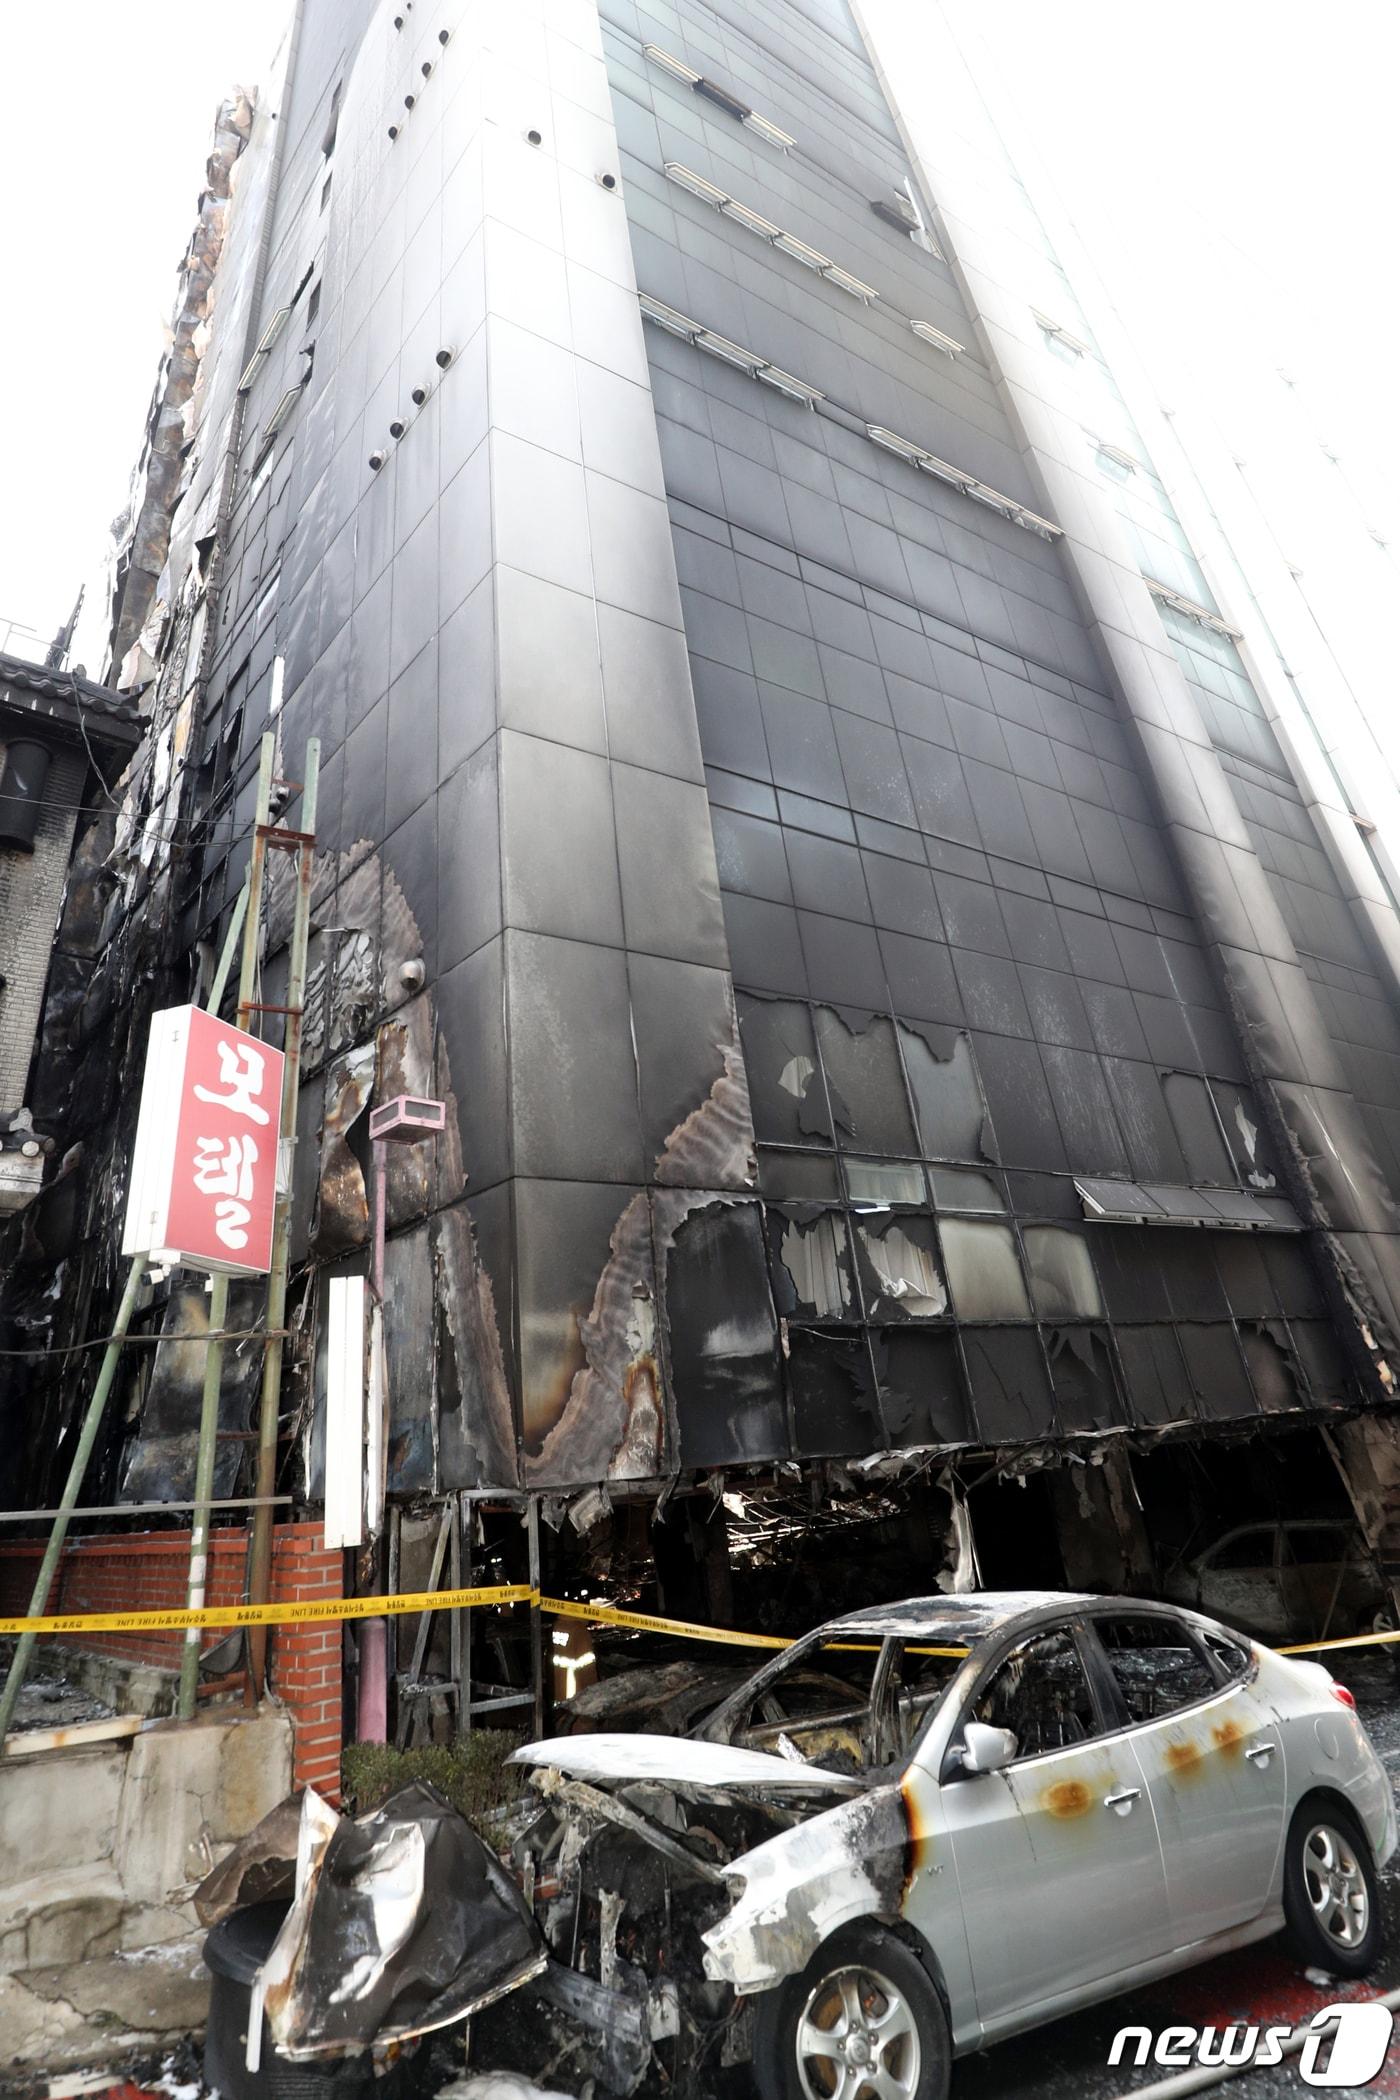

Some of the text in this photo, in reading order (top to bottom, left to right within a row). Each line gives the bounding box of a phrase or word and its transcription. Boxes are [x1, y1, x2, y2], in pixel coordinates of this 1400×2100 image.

[193, 1040, 270, 1250] 모텔
[290, 1608, 307, 1617] LINE
[308, 1607, 325, 1616] FIRE
[115, 1618, 135, 1627] LINE
[137, 1616, 156, 1625] FIRE
